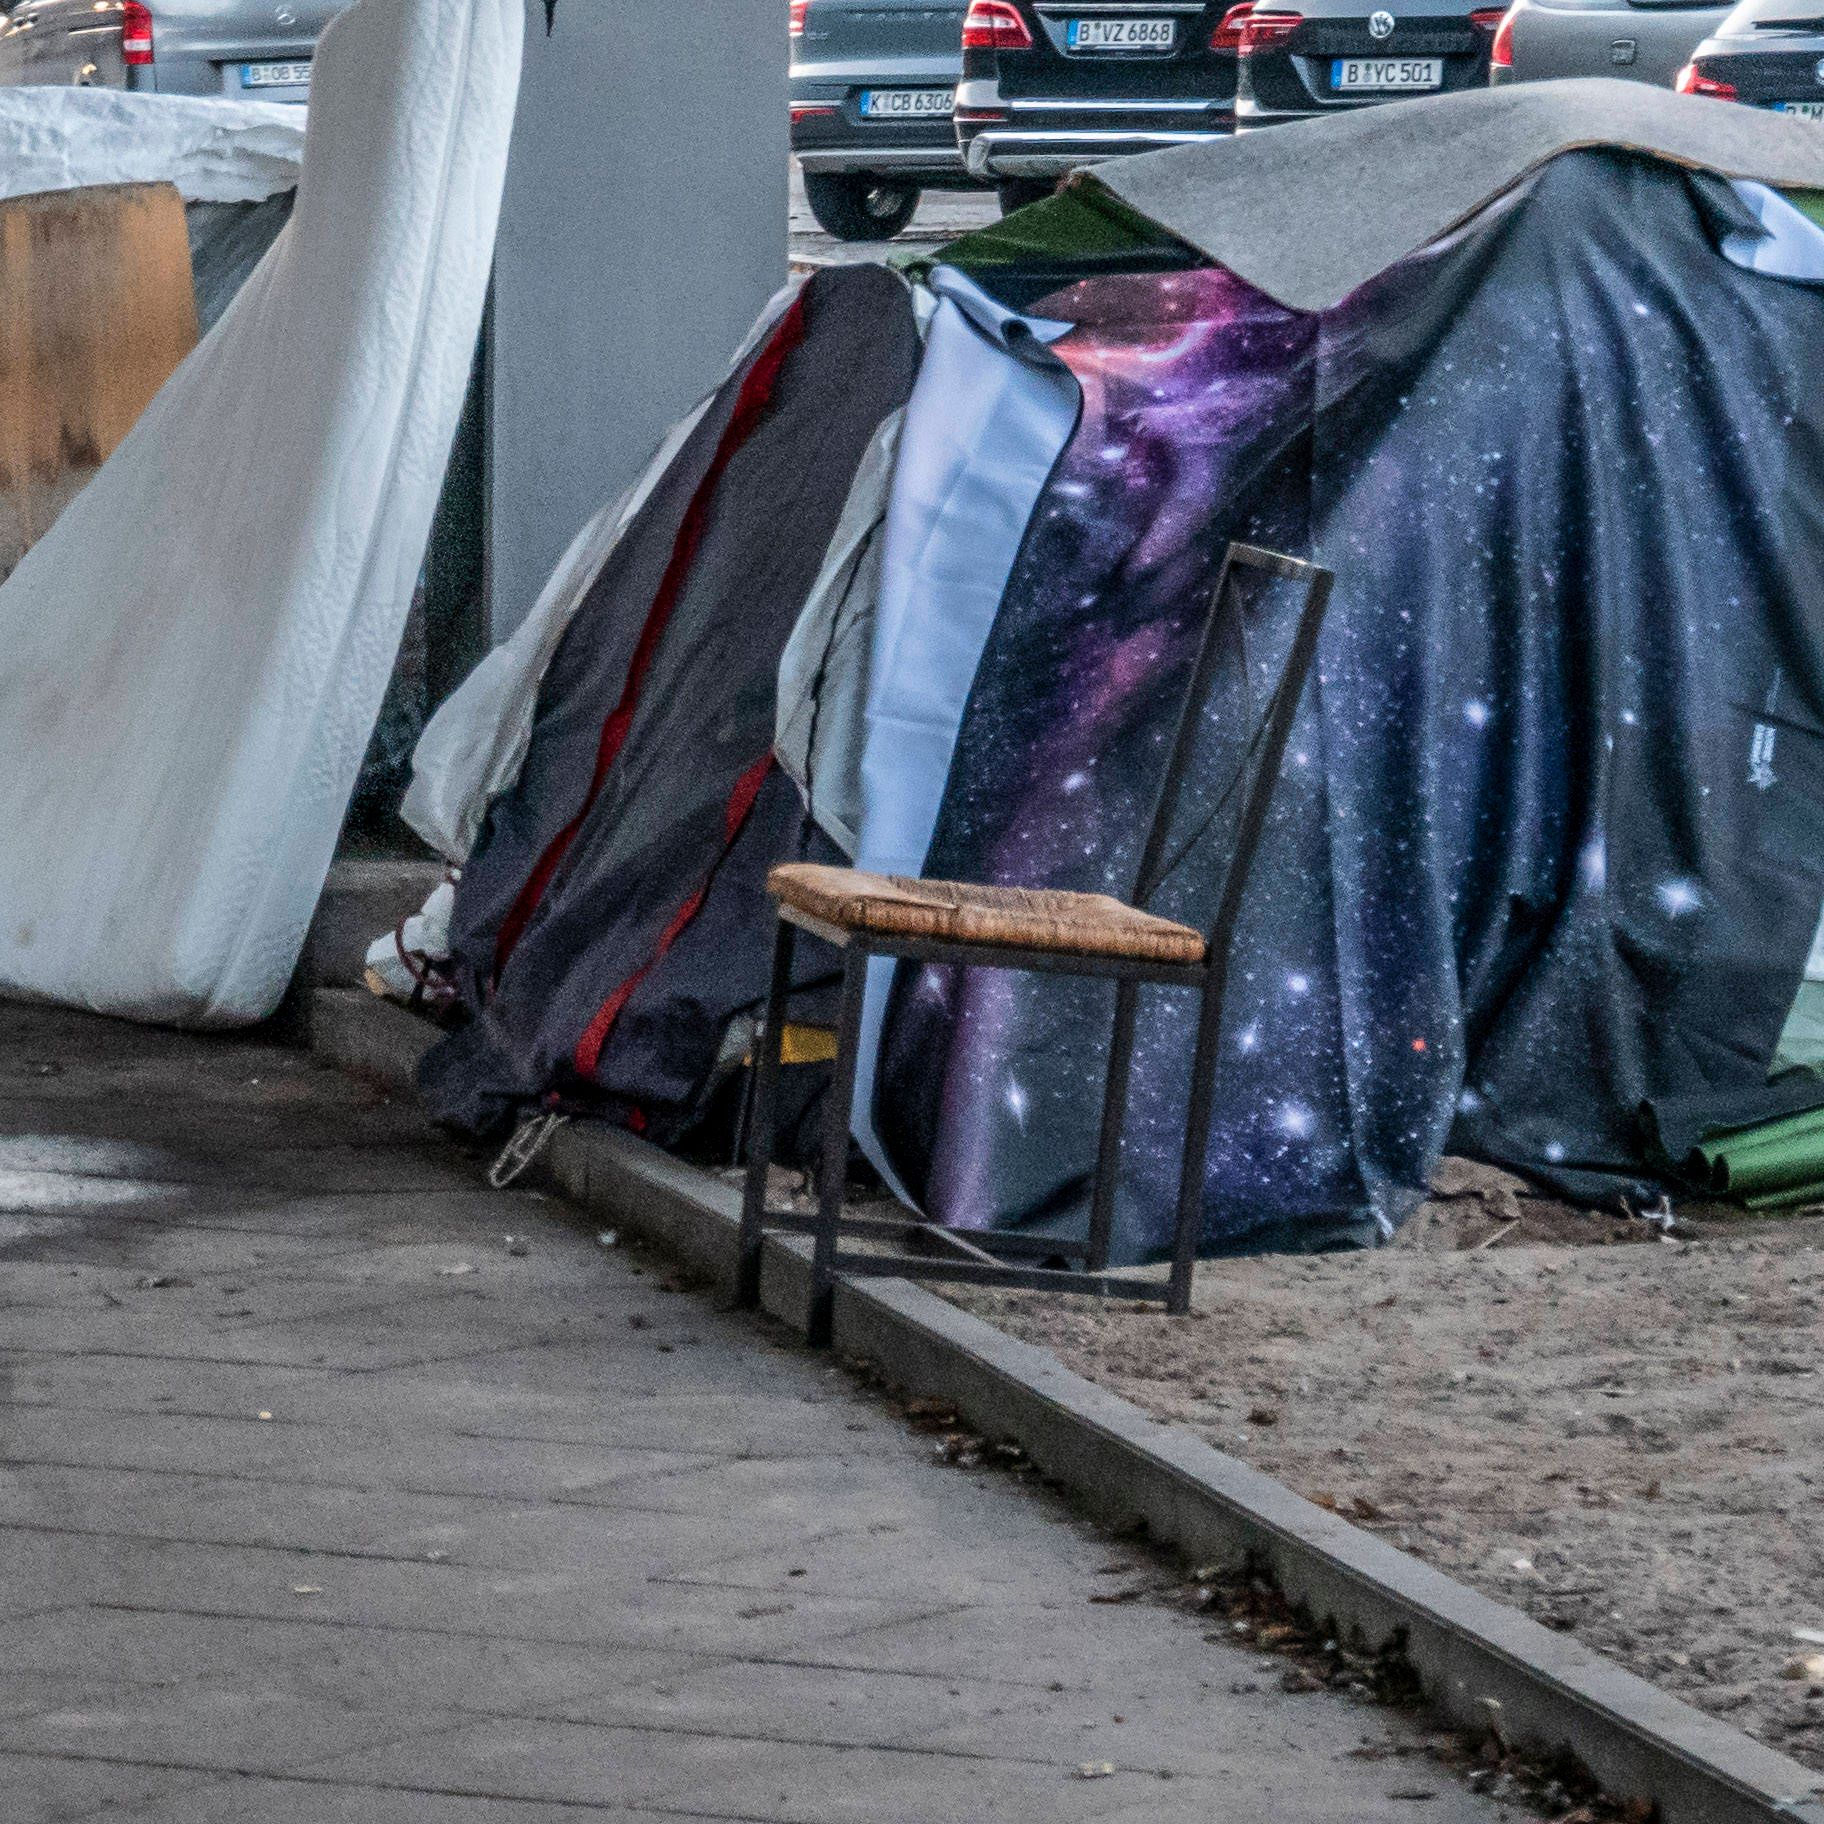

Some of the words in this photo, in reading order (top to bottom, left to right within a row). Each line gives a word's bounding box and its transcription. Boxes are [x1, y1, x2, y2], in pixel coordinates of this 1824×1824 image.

[1080, 22, 1090, 40] B
[1103, 22, 1125, 41] VZ
[1127, 21, 1170, 41] 6868
[1348, 64, 1359, 83] B
[1375, 63, 1396, 82] YC
[1400, 63, 1433, 82] 501
[914, 92, 952, 111] 6306
